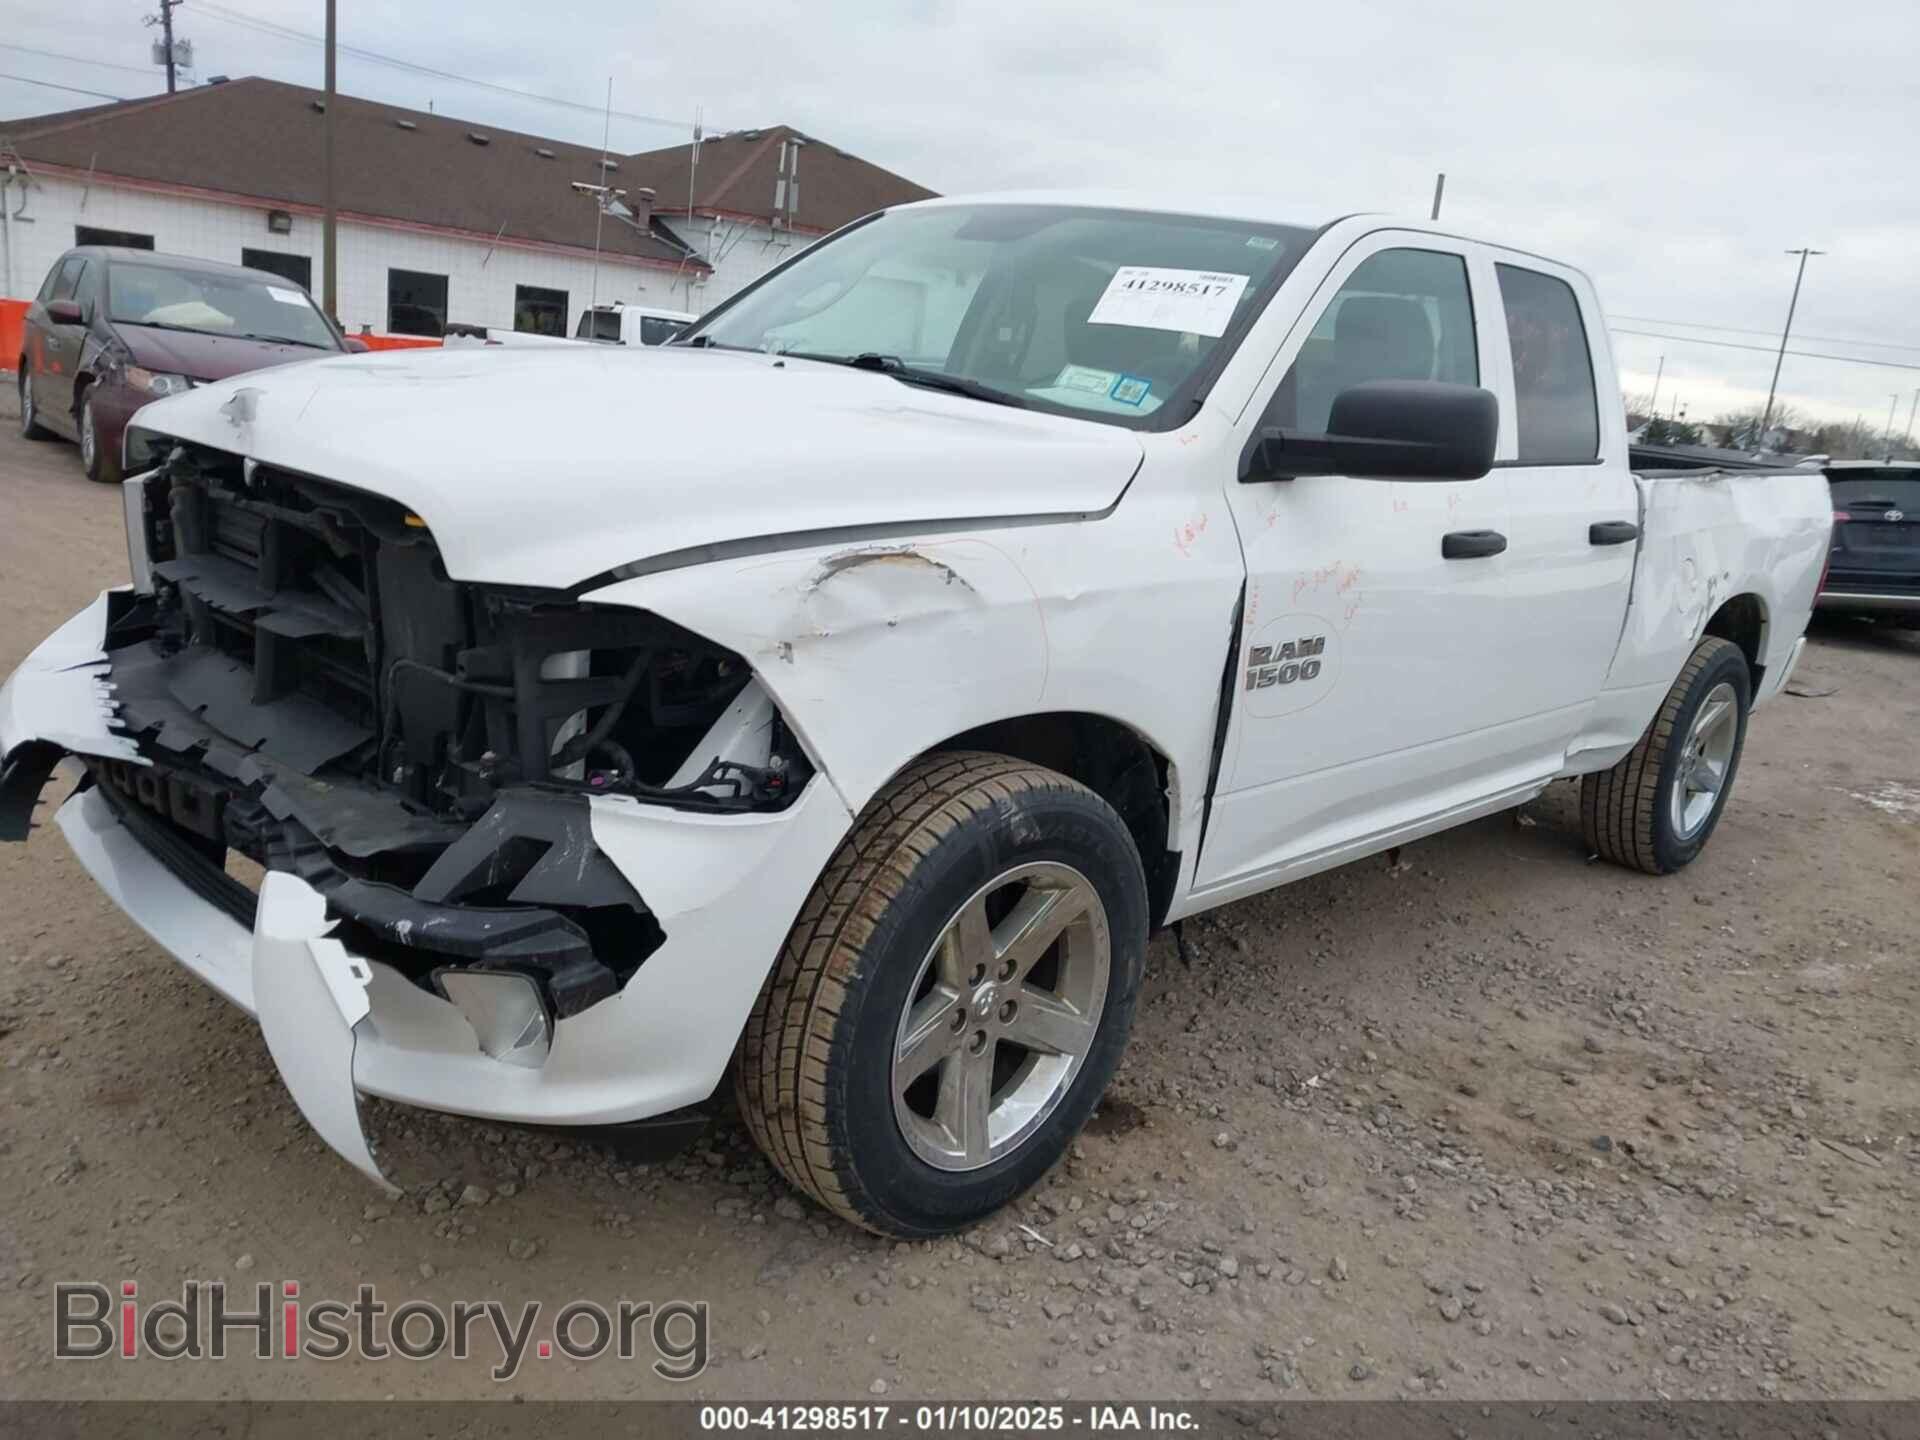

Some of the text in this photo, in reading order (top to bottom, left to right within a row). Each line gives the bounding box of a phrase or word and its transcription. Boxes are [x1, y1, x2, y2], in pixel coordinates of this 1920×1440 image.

[1122, 279, 1226, 296] 41298517
[1249, 636, 1325, 667] RAM
[1245, 660, 1321, 690] 1500
